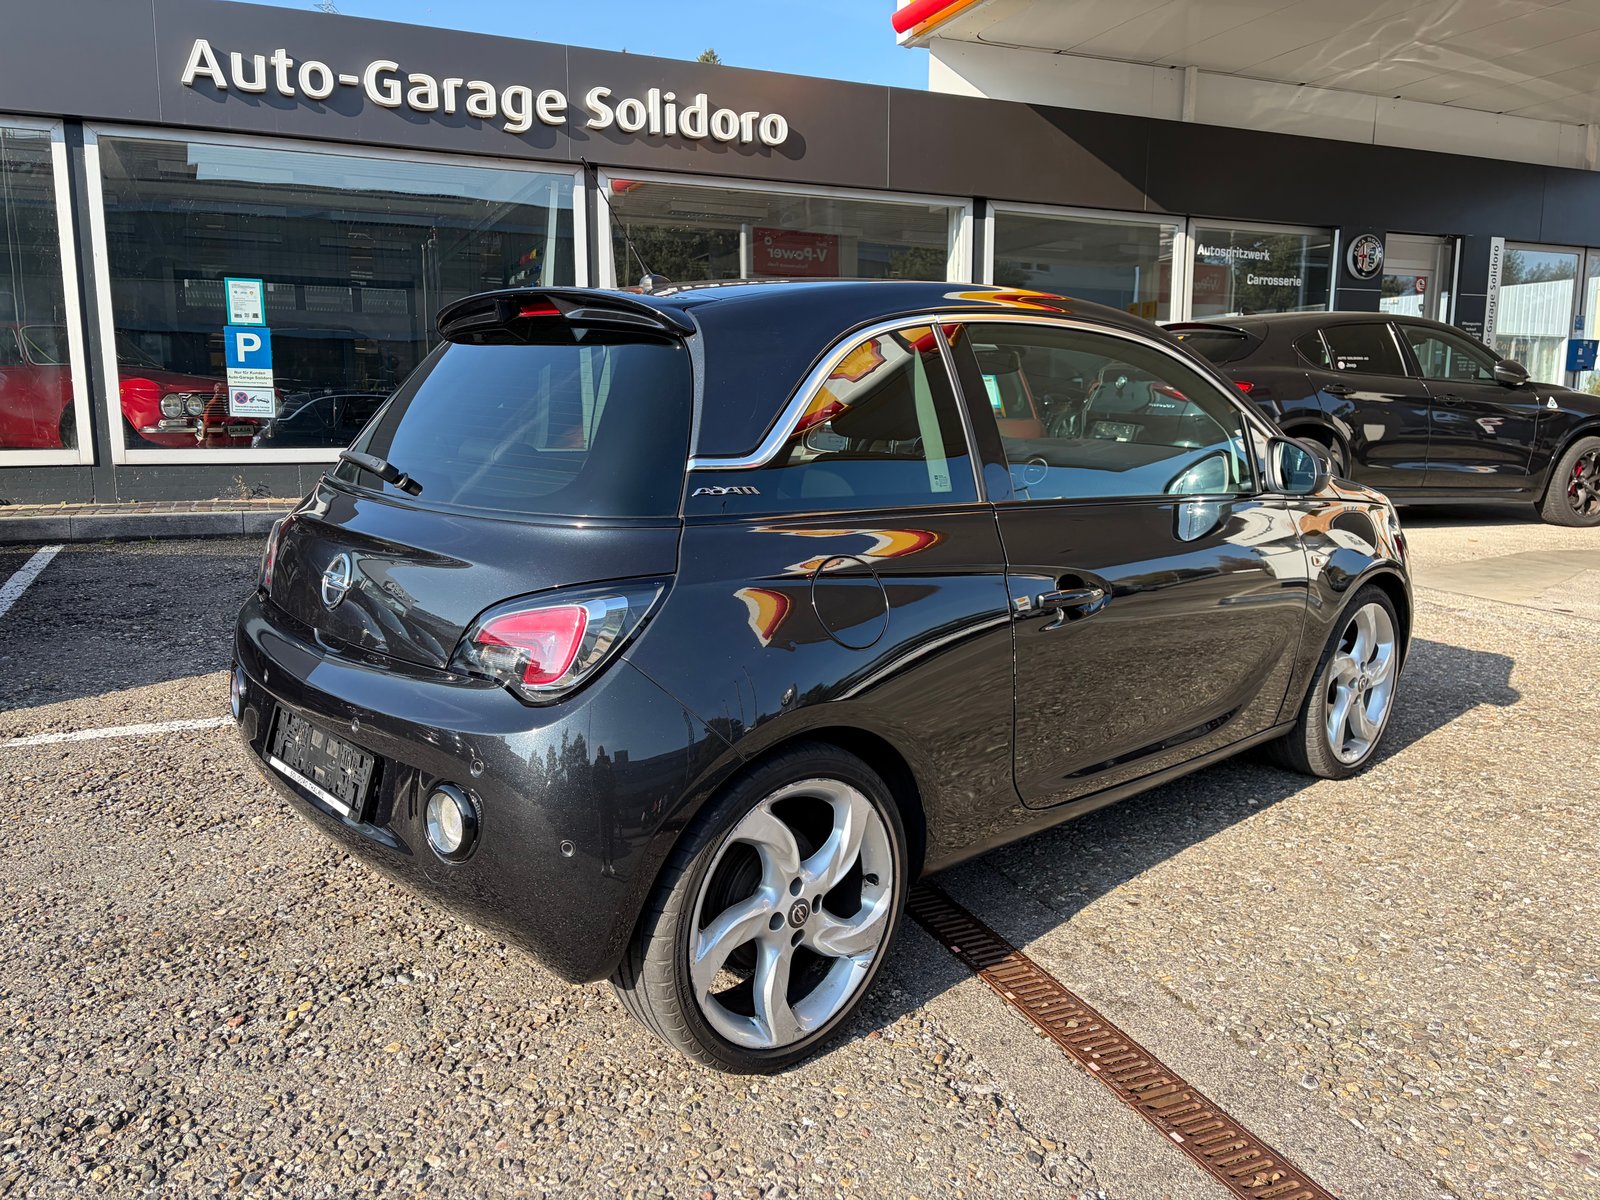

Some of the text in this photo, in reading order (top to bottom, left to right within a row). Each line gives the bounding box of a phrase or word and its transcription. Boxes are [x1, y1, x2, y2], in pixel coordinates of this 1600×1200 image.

[181, 38, 789, 146] Auto-Garage Solidoro
[1197, 243, 1271, 261] Autospritzwerk
[1247, 273, 1302, 287] Carrosserie
[1486, 245, 1500, 346] o-Garage Solidoro
[236, 332, 262, 363] P
